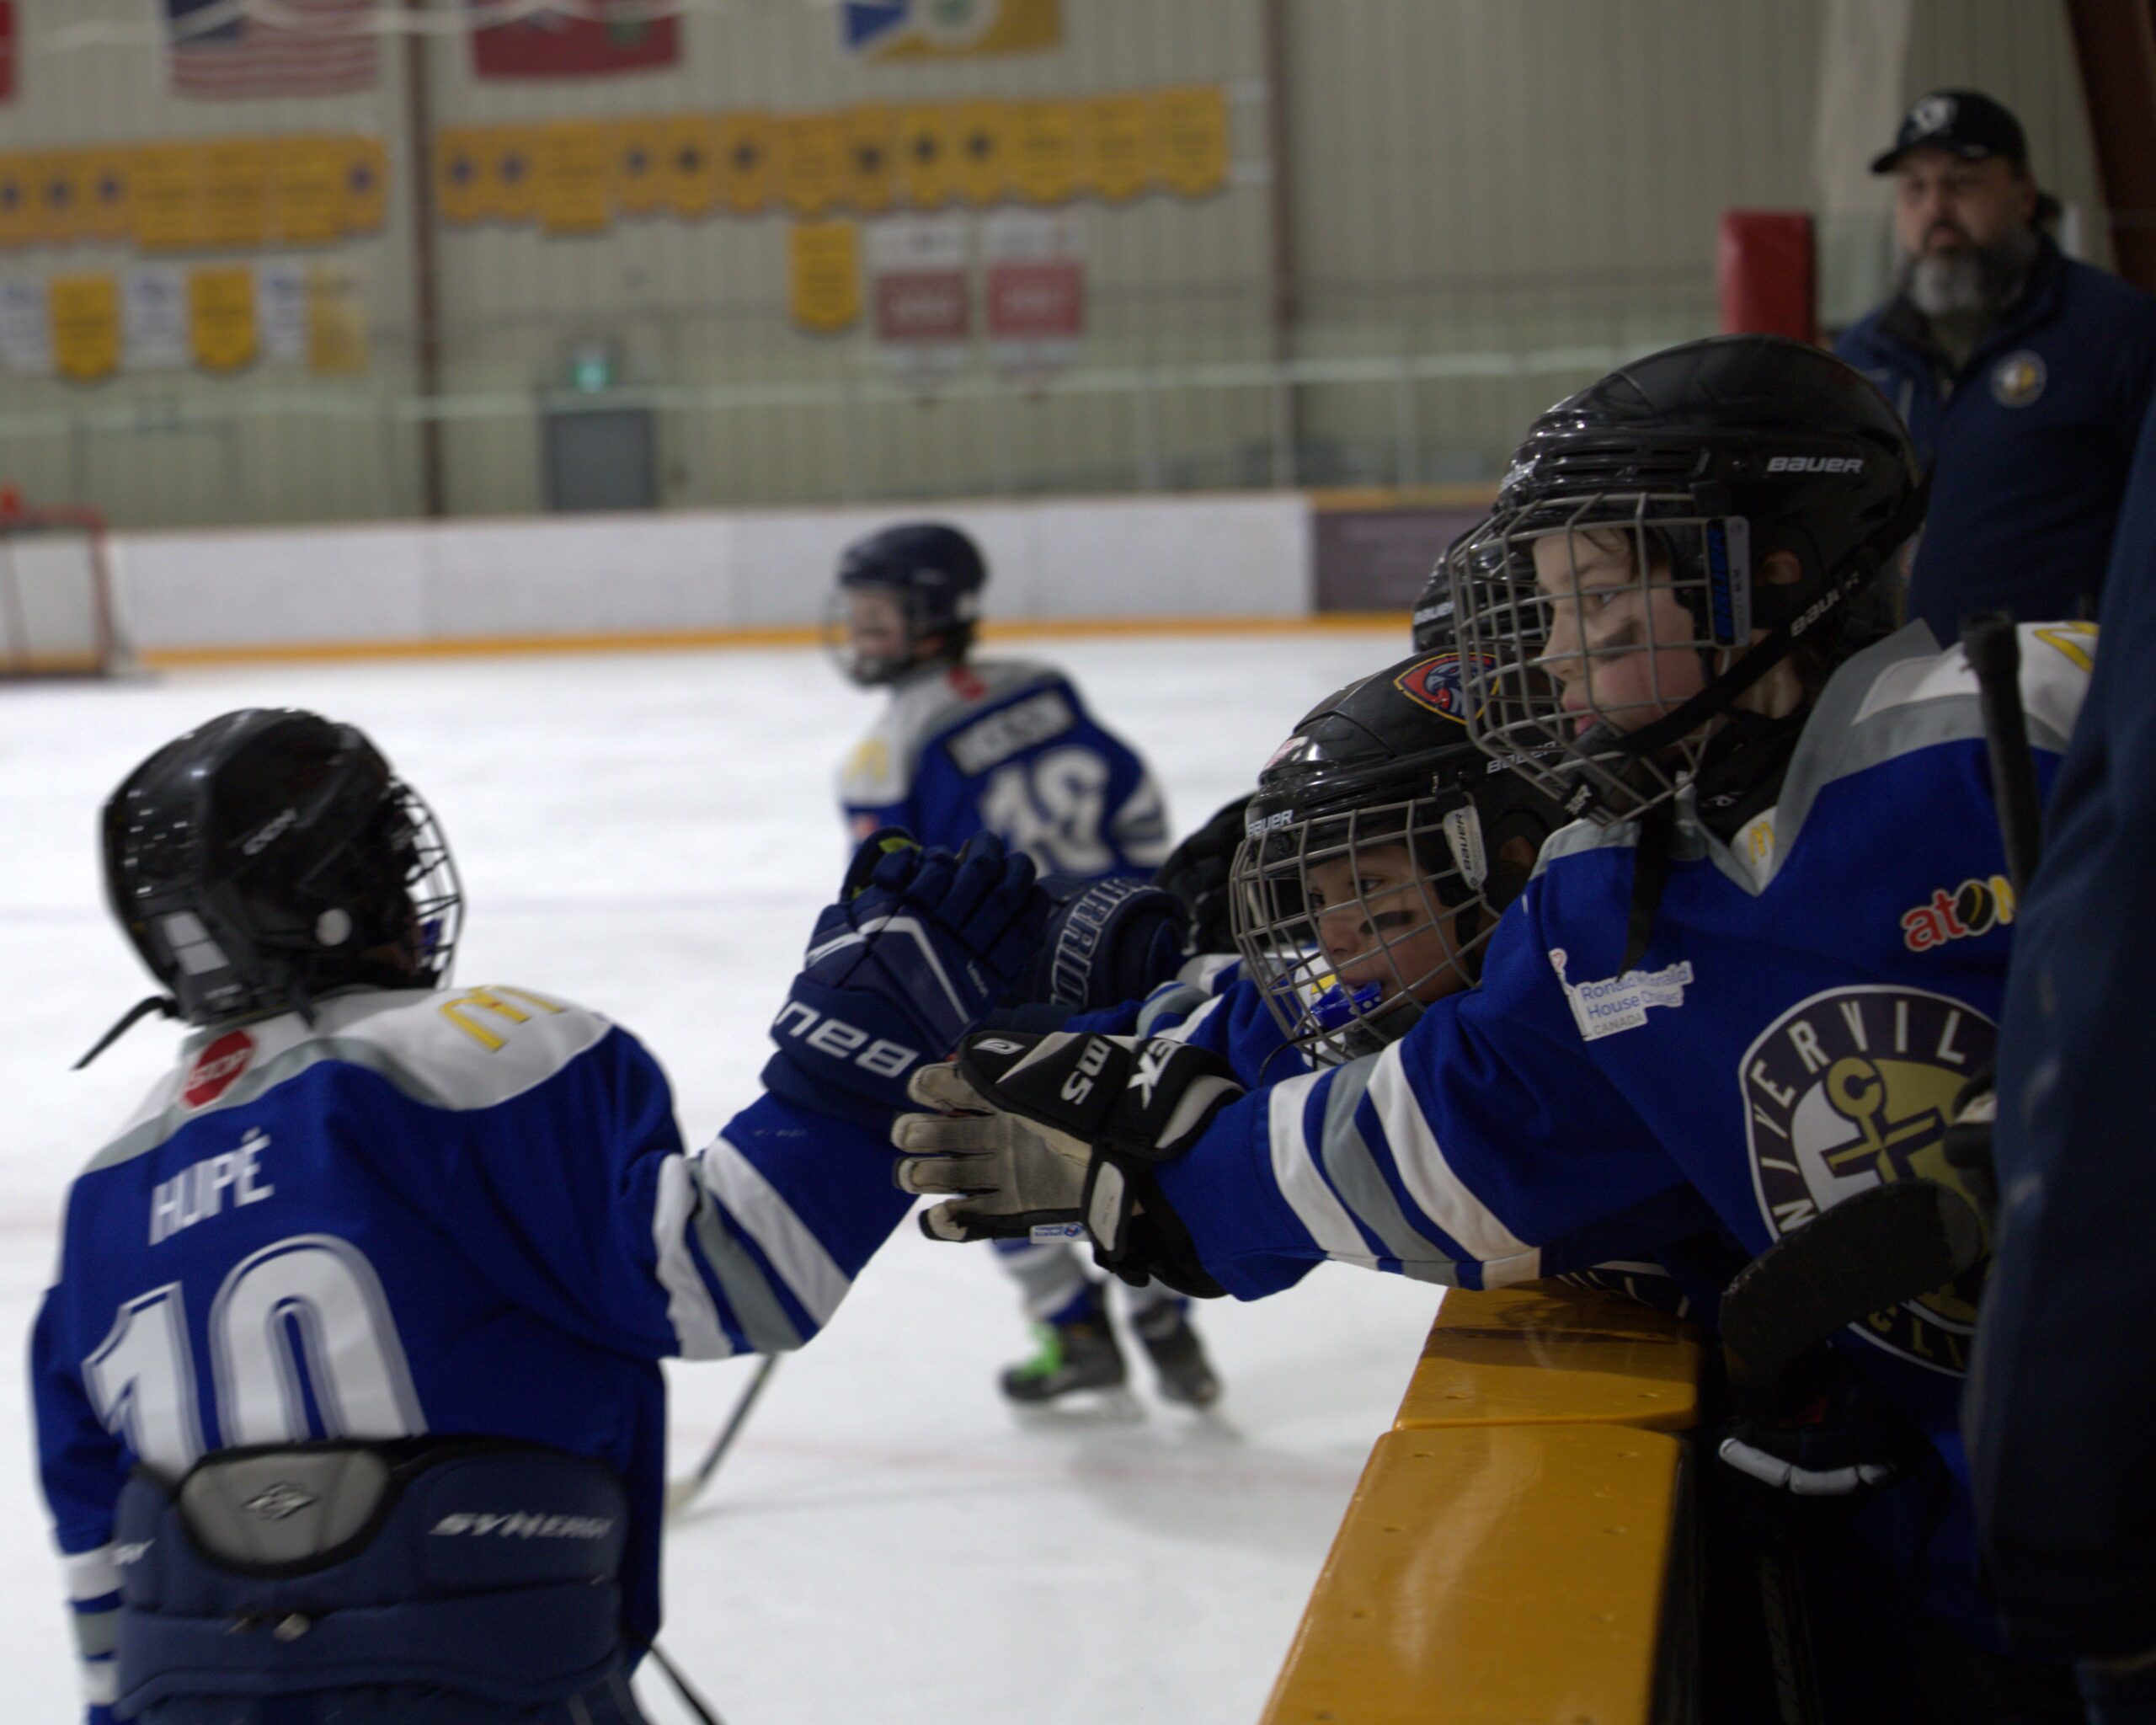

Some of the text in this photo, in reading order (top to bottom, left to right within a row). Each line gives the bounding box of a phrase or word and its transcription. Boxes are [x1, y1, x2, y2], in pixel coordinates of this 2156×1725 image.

[1766, 456, 1865, 474] BAUER
[773, 999, 922, 1079] BAU
[1586, 993, 1641, 1022] House
[1749, 999, 1967, 1235] NIVERVIL
[147, 1124, 276, 1248] HUPÉ
